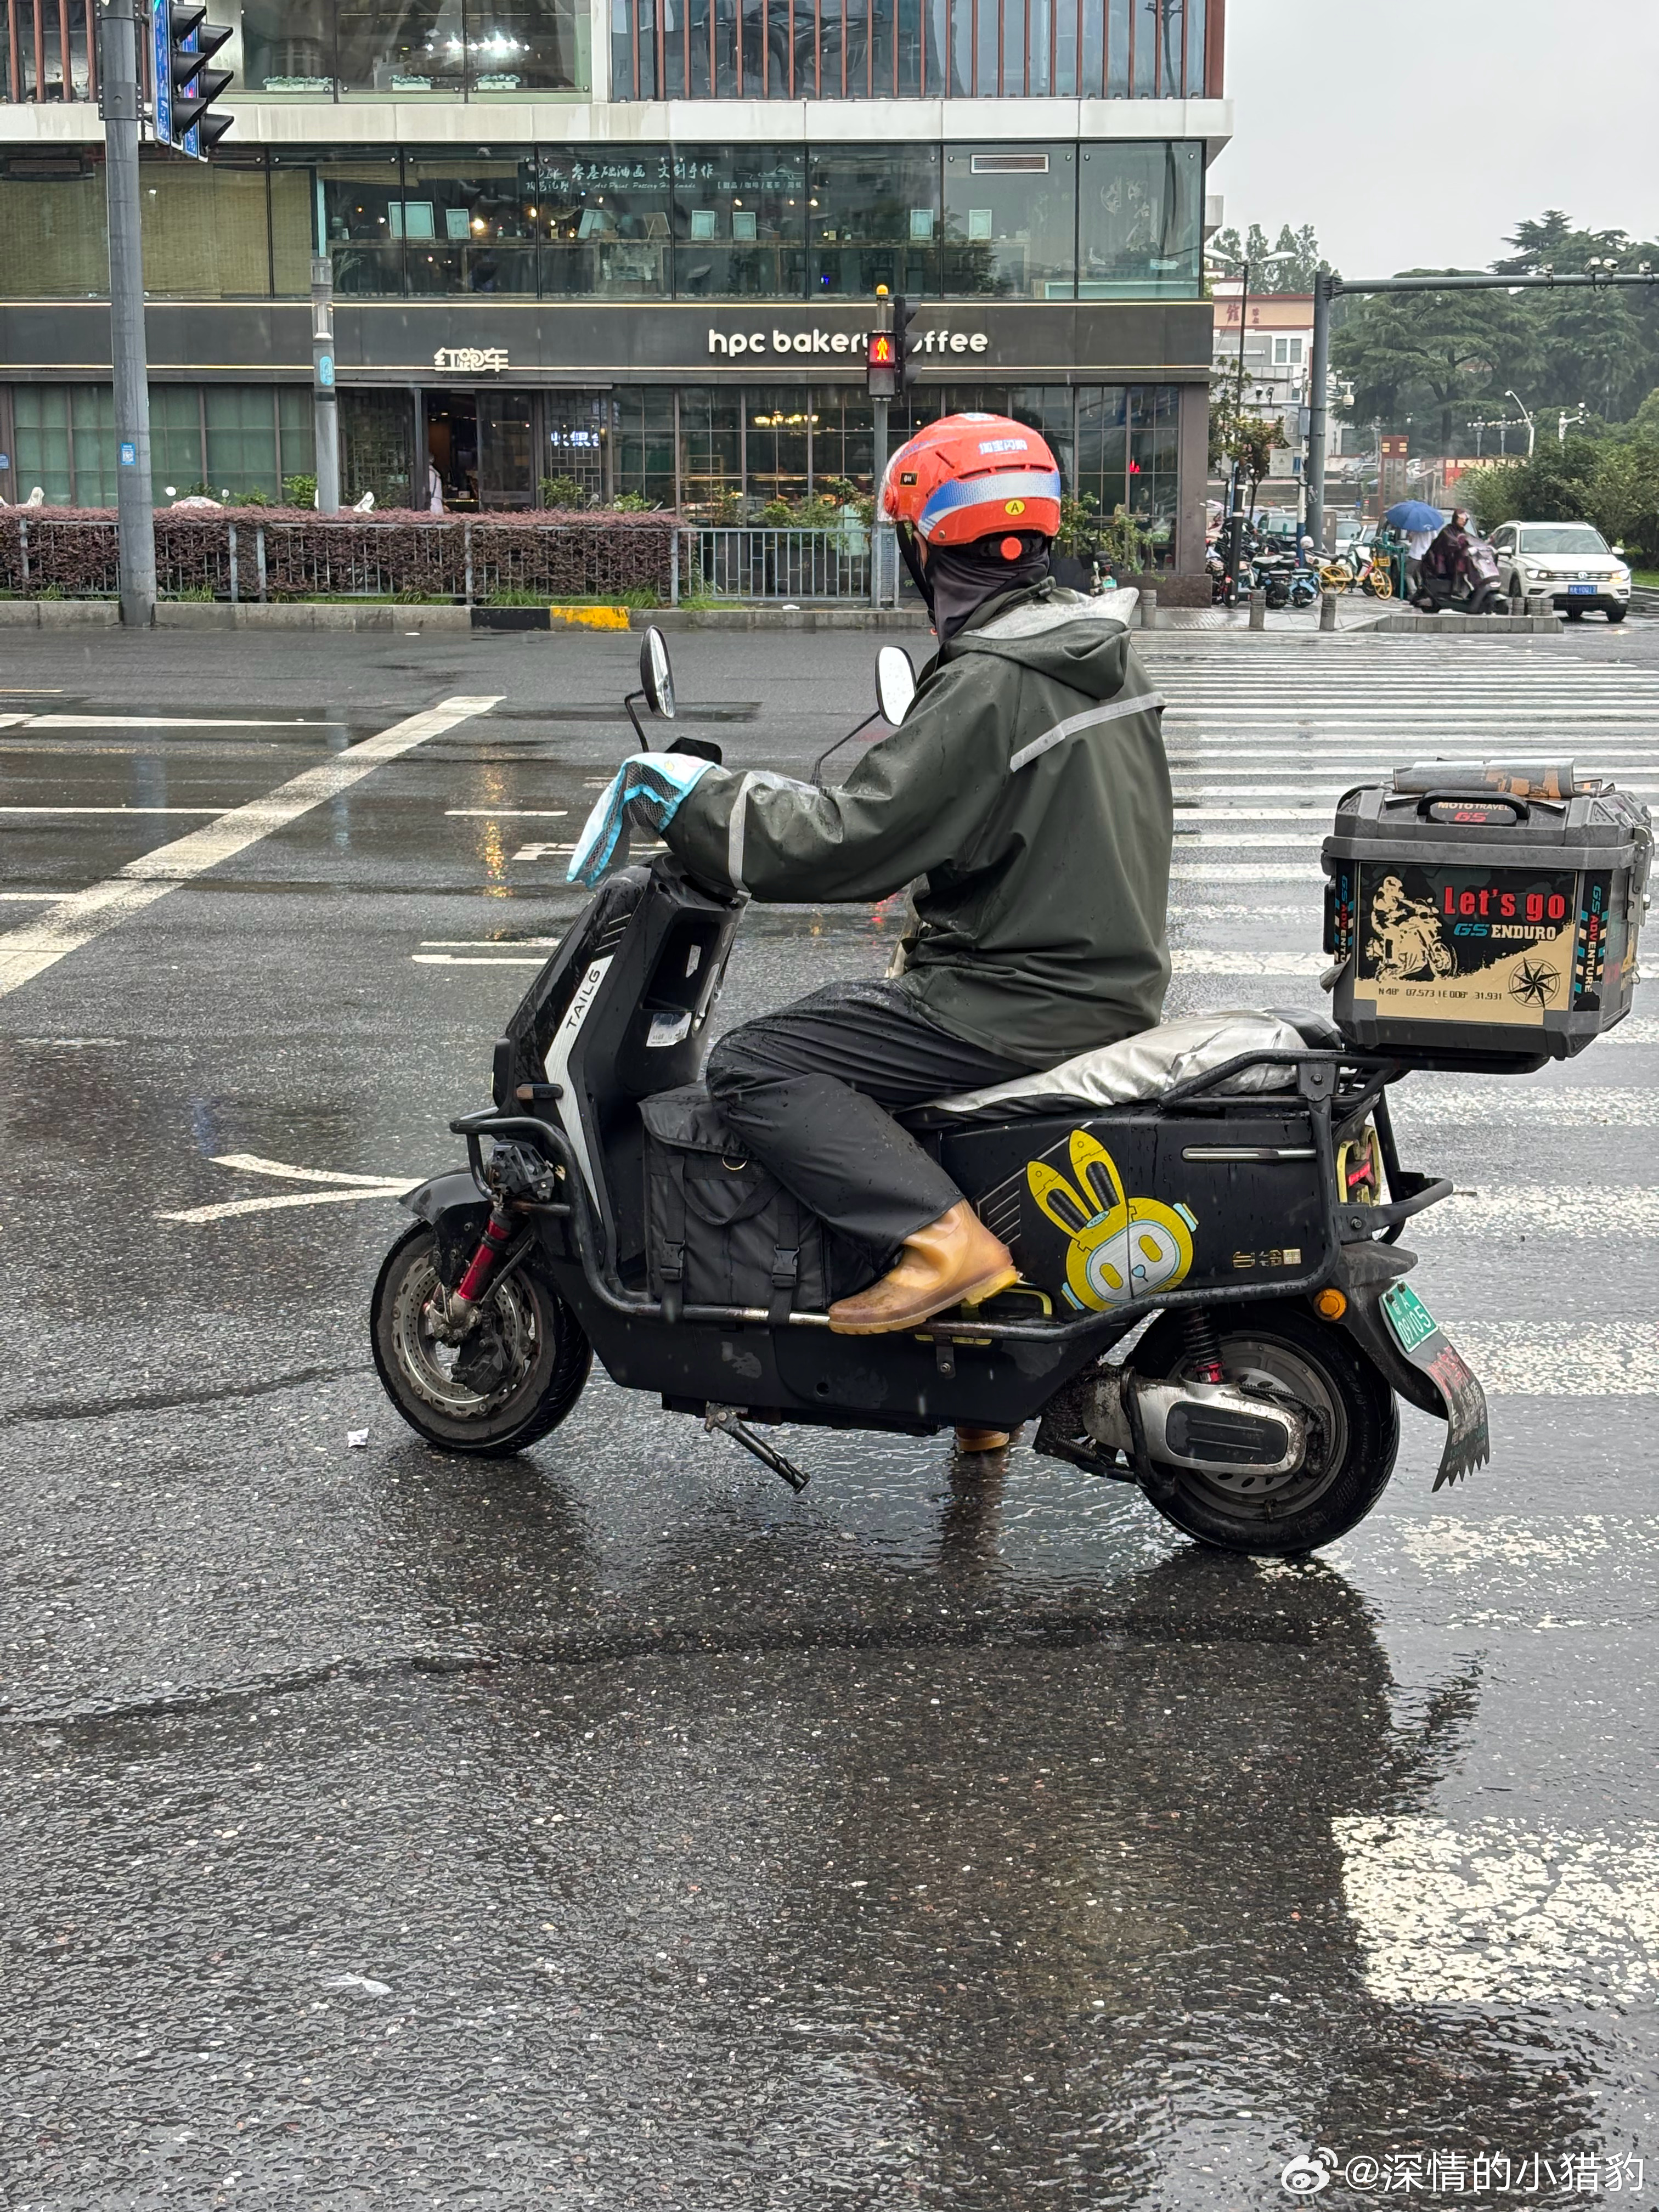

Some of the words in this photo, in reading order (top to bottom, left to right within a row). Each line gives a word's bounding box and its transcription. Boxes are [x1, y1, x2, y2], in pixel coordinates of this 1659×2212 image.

[572, 163, 645, 180] 零基础油画
[709, 329, 765, 357] hpc
[433, 347, 509, 372] 红跑车
[1011, 502, 1019, 512] A
[1443, 886, 1516, 917] Let's
[1525, 893, 1565, 922] go
[1453, 923, 1490, 936] GS
[1491, 924, 1556, 940] ENDURO
[1584, 915, 1600, 993] ADVENTURE
[566, 969, 600, 1029] TAILG
[1475, 992, 1502, 1000] 31.931
